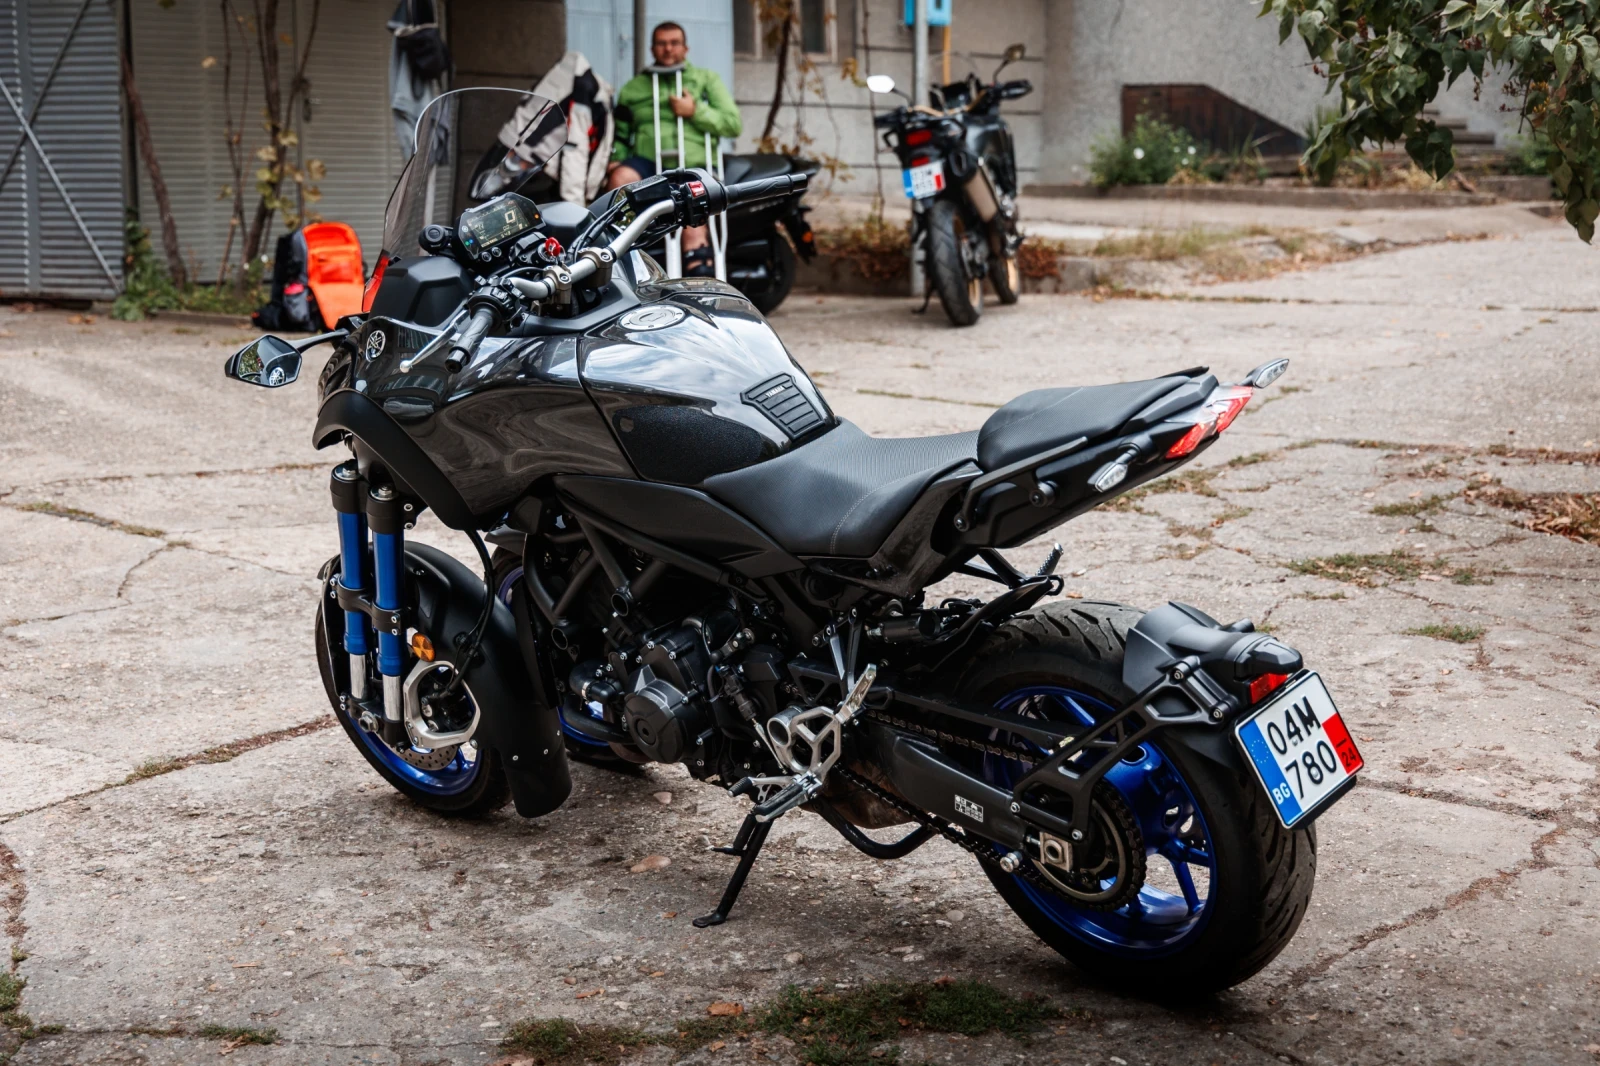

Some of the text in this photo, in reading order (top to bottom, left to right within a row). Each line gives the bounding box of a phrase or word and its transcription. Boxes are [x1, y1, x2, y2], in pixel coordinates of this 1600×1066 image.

[1267, 696, 1321, 755] 04M
[1272, 782, 1291, 805] BG
[1285, 740, 1337, 799] 780
